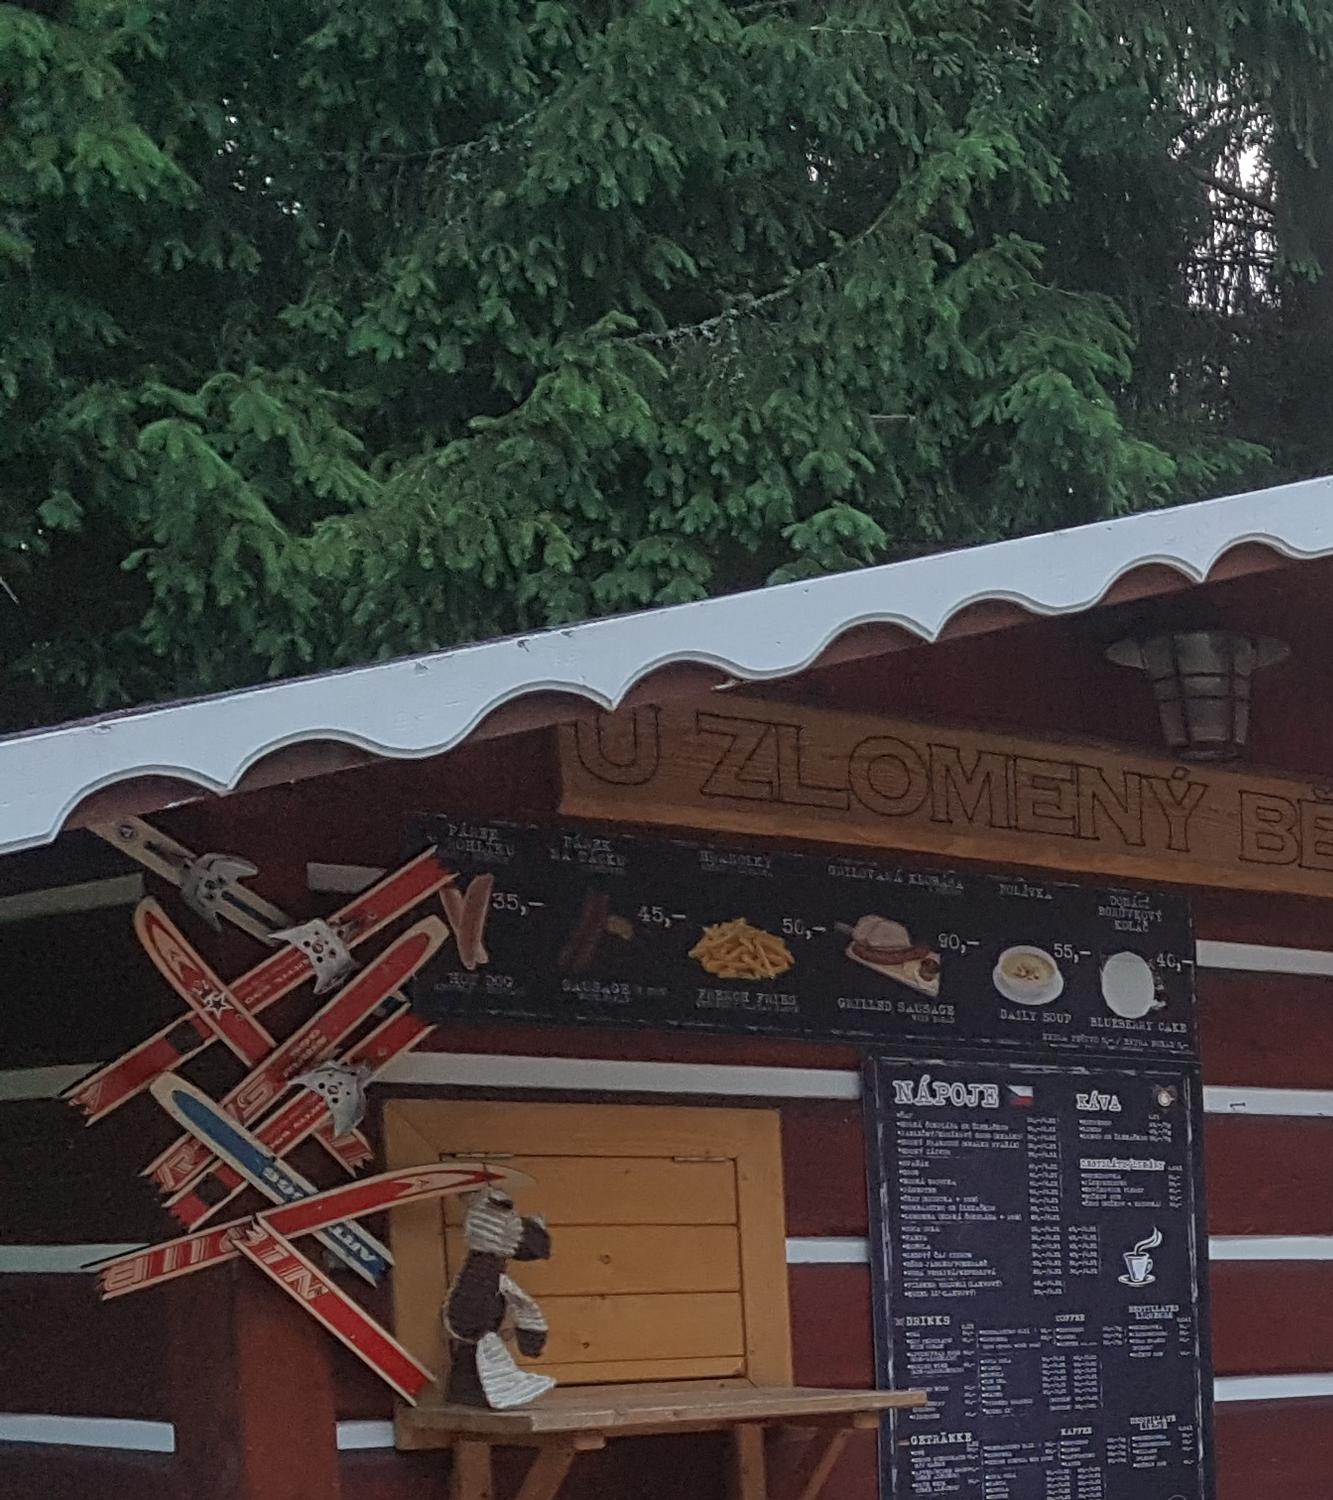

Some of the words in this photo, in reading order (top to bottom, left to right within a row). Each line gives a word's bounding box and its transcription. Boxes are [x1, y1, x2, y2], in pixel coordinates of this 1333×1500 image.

[568, 704, 661, 786] U
[697, 712, 1209, 853] ZLOMENÝ
[837, 997, 892, 1013] GRILLED
[897, 1000, 955, 1017] SAUSAGE
[1000, 1008, 1037, 1022] DAILY
[1042, 1012, 1072, 1024] SOUP
[1090, 1016, 1153, 1032] BLUEBERRY
[1158, 1021, 1187, 1034] CAKE
[892, 1074, 1000, 1108] NÁPOJE
[1076, 1091, 1122, 1112] KÁVA
[906, 1316, 950, 1326] DRINKS
[910, 1431, 973, 1446] GETRÄNKE
